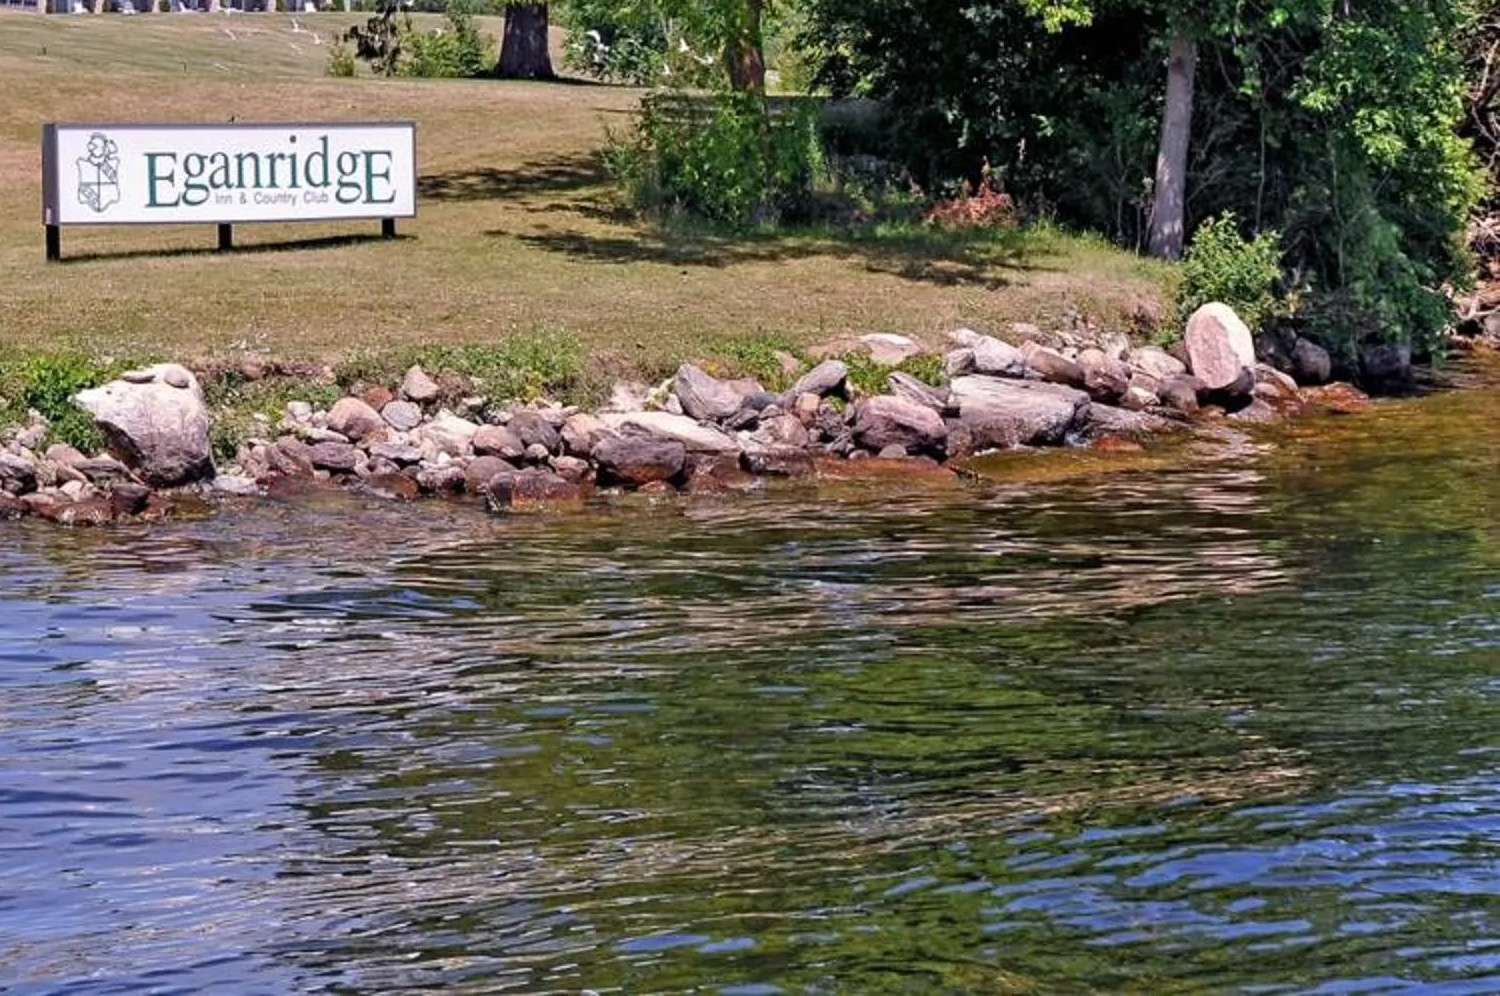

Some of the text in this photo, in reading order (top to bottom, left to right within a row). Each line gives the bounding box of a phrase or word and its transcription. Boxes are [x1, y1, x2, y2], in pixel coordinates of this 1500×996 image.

[214, 189, 329, 207] Inn & Country Club
